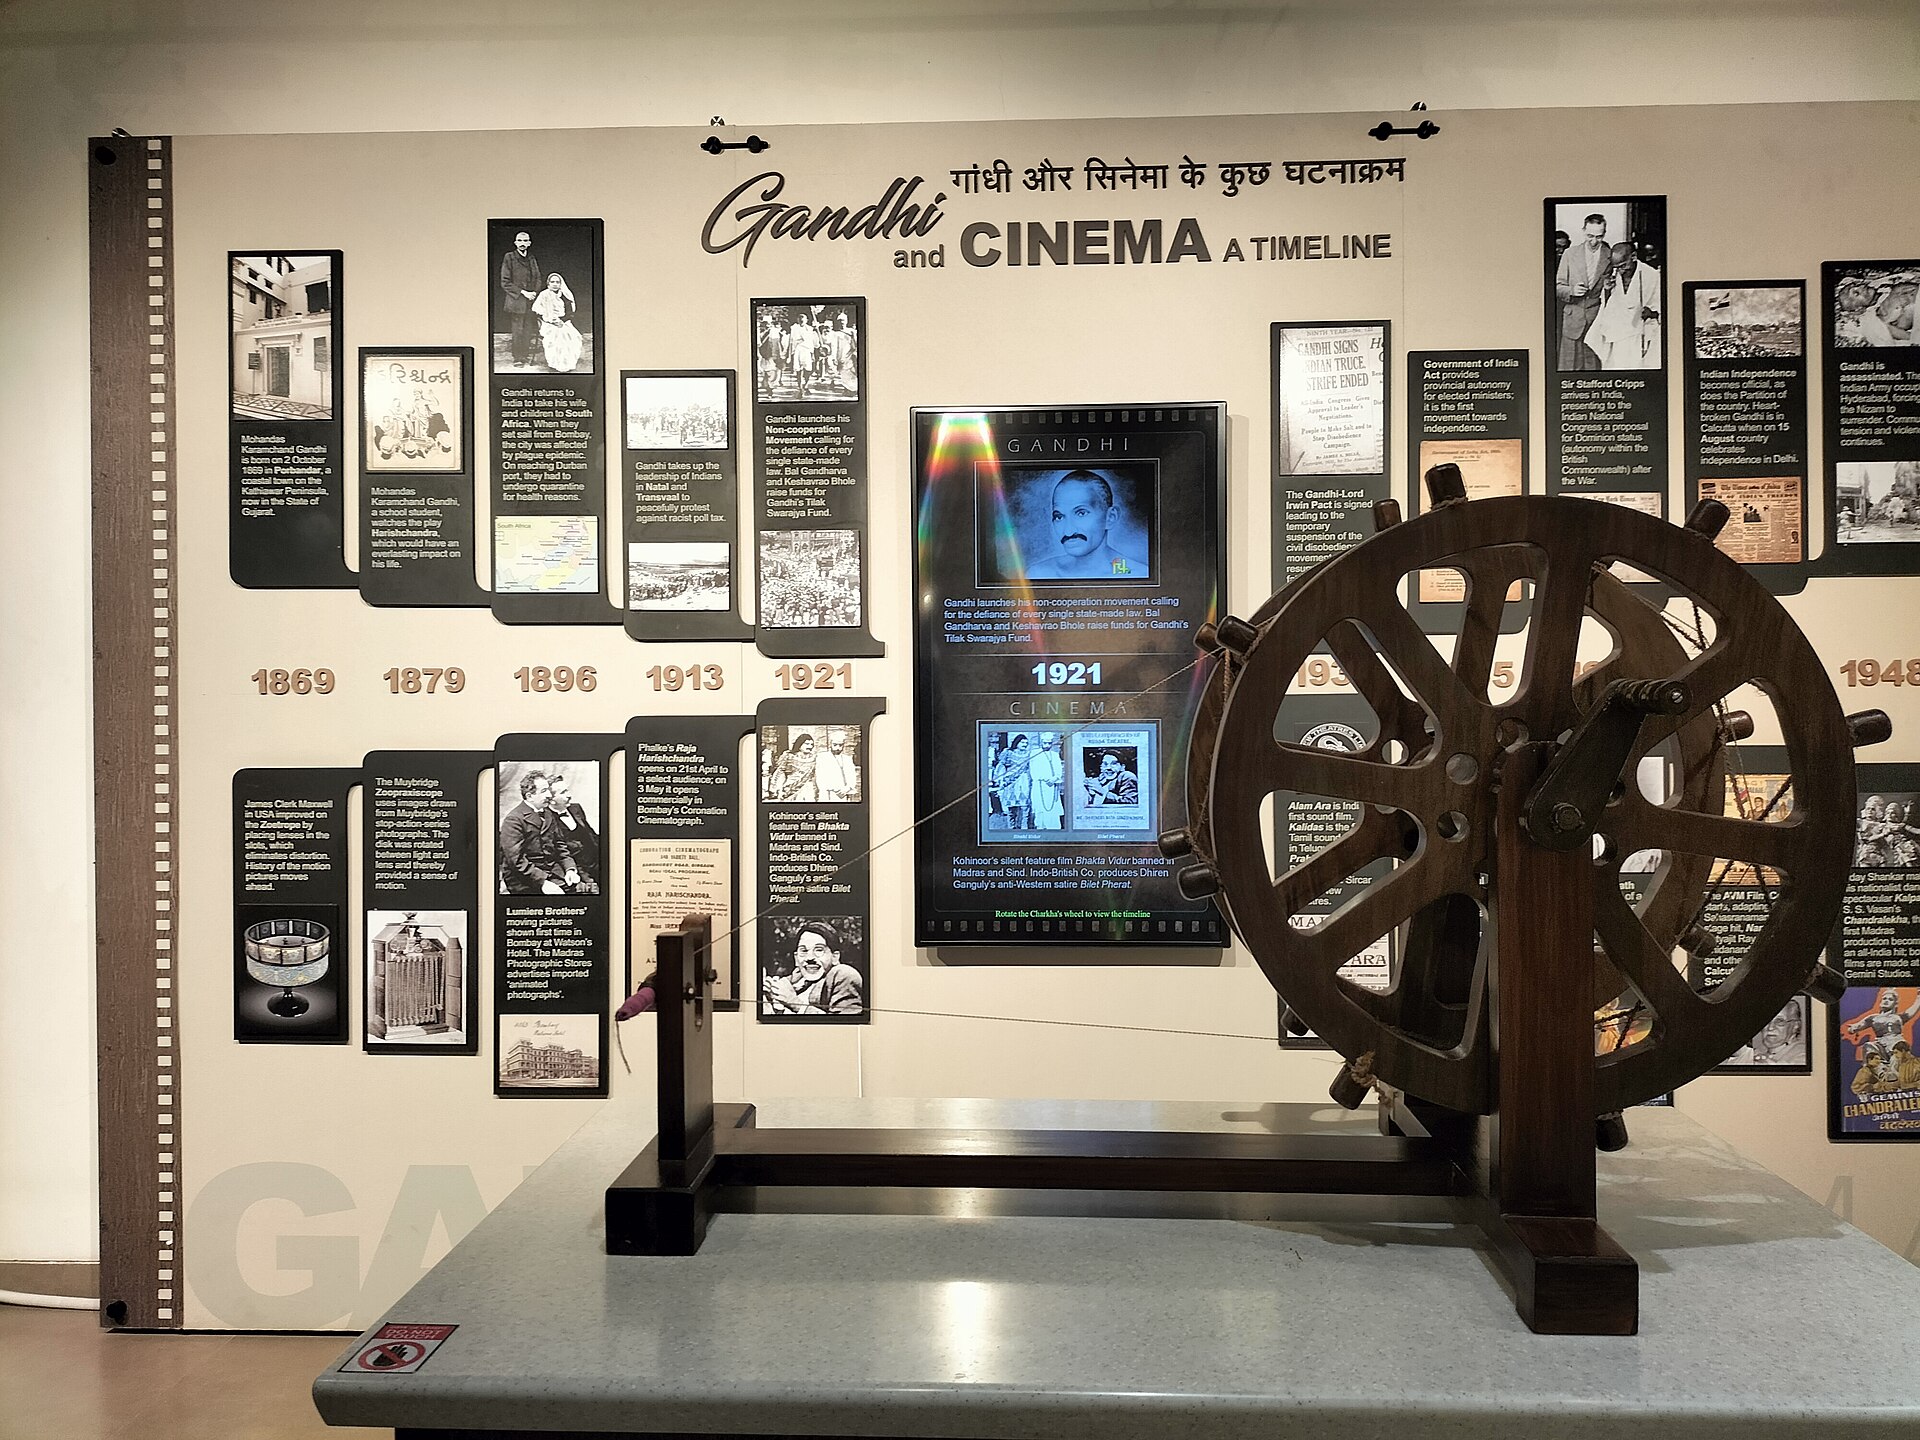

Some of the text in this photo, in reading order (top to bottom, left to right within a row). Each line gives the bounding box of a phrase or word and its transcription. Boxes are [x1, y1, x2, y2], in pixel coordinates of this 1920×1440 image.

[950, 155, 1406, 197] गांधी और सिनेमा के कुछ घटनाक्रम
[701, 171, 947, 268] Gandhi
[894, 218, 1391, 268] and CINEMA A TIMELINE
[1298, 339, 1358, 356] GANDHI SIGNS
[1423, 359, 1519, 368] Government of India
[1423, 370, 1479, 380] Act provides
[1306, 372, 1368, 391] STRIFE ENDED
[1424, 381, 1511, 391] provincial autonomy
[1424, 392, 1436, 400] for
[1438, 392, 1470, 400] elected
[1424, 402, 1474, 411] it is the first
[1472, 413, 1507, 421] towards
[1424, 424, 1488, 434] independence.
[1008, 438, 1127, 452] GANDHI
[636, 462, 666, 470] Gandhi
[668, 462, 691, 470] takes
[636, 472, 722, 481] leadership of Indians
[636, 493, 680, 501] Transvaal
[1305, 490, 1364, 498] Gandhi-Lord
[1286, 501, 1309, 509] Irwin
[1311, 501, 1332, 509] Pact
[1344, 500, 1373, 510] signed
[1286, 512, 1318, 521] leading
[1331, 511, 1344, 519] the
[1286, 523, 1330, 532] temporary
[1286, 532, 1363, 542] suspension of the
[944, 599, 976, 607] Gandhi
[977, 599, 1016, 607] launches
[1033, 598, 1102, 607] non-cooperation
[1104, 598, 1149, 606] movement
[1151, 597, 1179, 606] calling
[944, 611, 956, 619] for
[974, 610, 1010, 618] defiance
[1012, 610, 1021, 618] of
[1048, 610, 1074, 619] single
[1126, 609, 1143, 617] law.
[1146, 609, 1160, 617] Bal
[944, 620, 1189, 630] Gandharva and Keshavrao Bhole raise funds for Gandhi's
[944, 634, 1033, 644] Tilak Swarajya Fund.
[646, 664, 724, 691] 1913
[775, 663, 851, 690] 1921
[1032, 663, 1100, 685] 1921
[1297, 660, 1350, 688] 193
[1840, 659, 1920, 687] 1948
[251, 668, 335, 695] 1869
[383, 666, 466, 694] 1879
[513, 666, 597, 693] 1896
[1010, 702, 1126, 715] CINEMA
[1288, 802, 1313, 810] Alam
[1314, 802, 1331, 810] Ara
[1307, 812, 1333, 820] sound
[1335, 812, 1354, 820] film.
[1289, 823, 1324, 831] Kalidas
[1326, 823, 1333, 831] is
[953, 857, 998, 865] Kohinoor's
[1000, 857, 1023, 865] silent
[1025, 857, 1055, 865] feature
[953, 868, 1169, 878] Madras and Sind. Indo-British Co. produces Dhiren
[953, 880, 1132, 890] Ganguly's anti-Western satire Bilet Pherat.
[506, 918, 573, 927] moving pictures
[536, 928, 552, 936] first
[554, 928, 572, 936] time
[507, 939, 542, 948] Bombay
[554, 938, 592, 946] Watson's
[1844, 1098, 1920, 1117] CHANDRALE
[187, 1161, 531, 1330] GA
